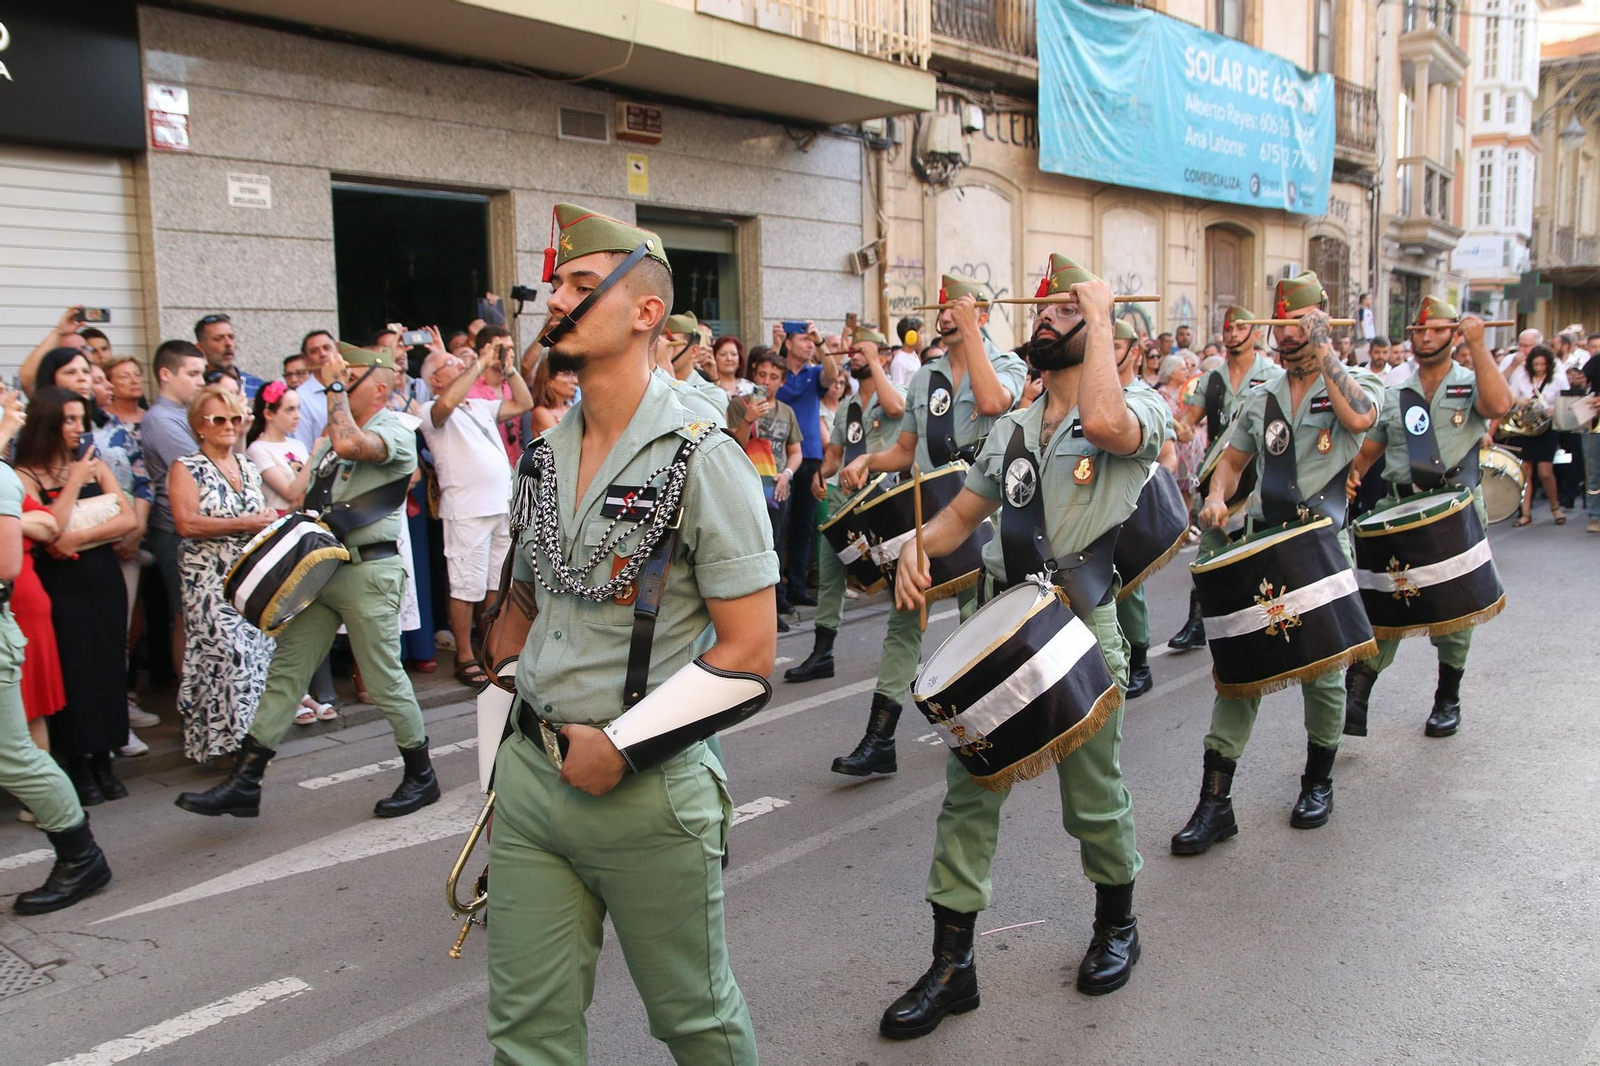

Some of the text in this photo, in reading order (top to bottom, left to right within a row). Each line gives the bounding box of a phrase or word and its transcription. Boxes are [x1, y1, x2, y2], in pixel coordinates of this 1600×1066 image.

[1184, 45, 1243, 93] SOLAR
[1246, 65, 1269, 100] DE
[1185, 91, 1226, 122] Alberto
[1185, 126, 1206, 149] Ana
[1184, 167, 1242, 190] COMERCIALIZA:
